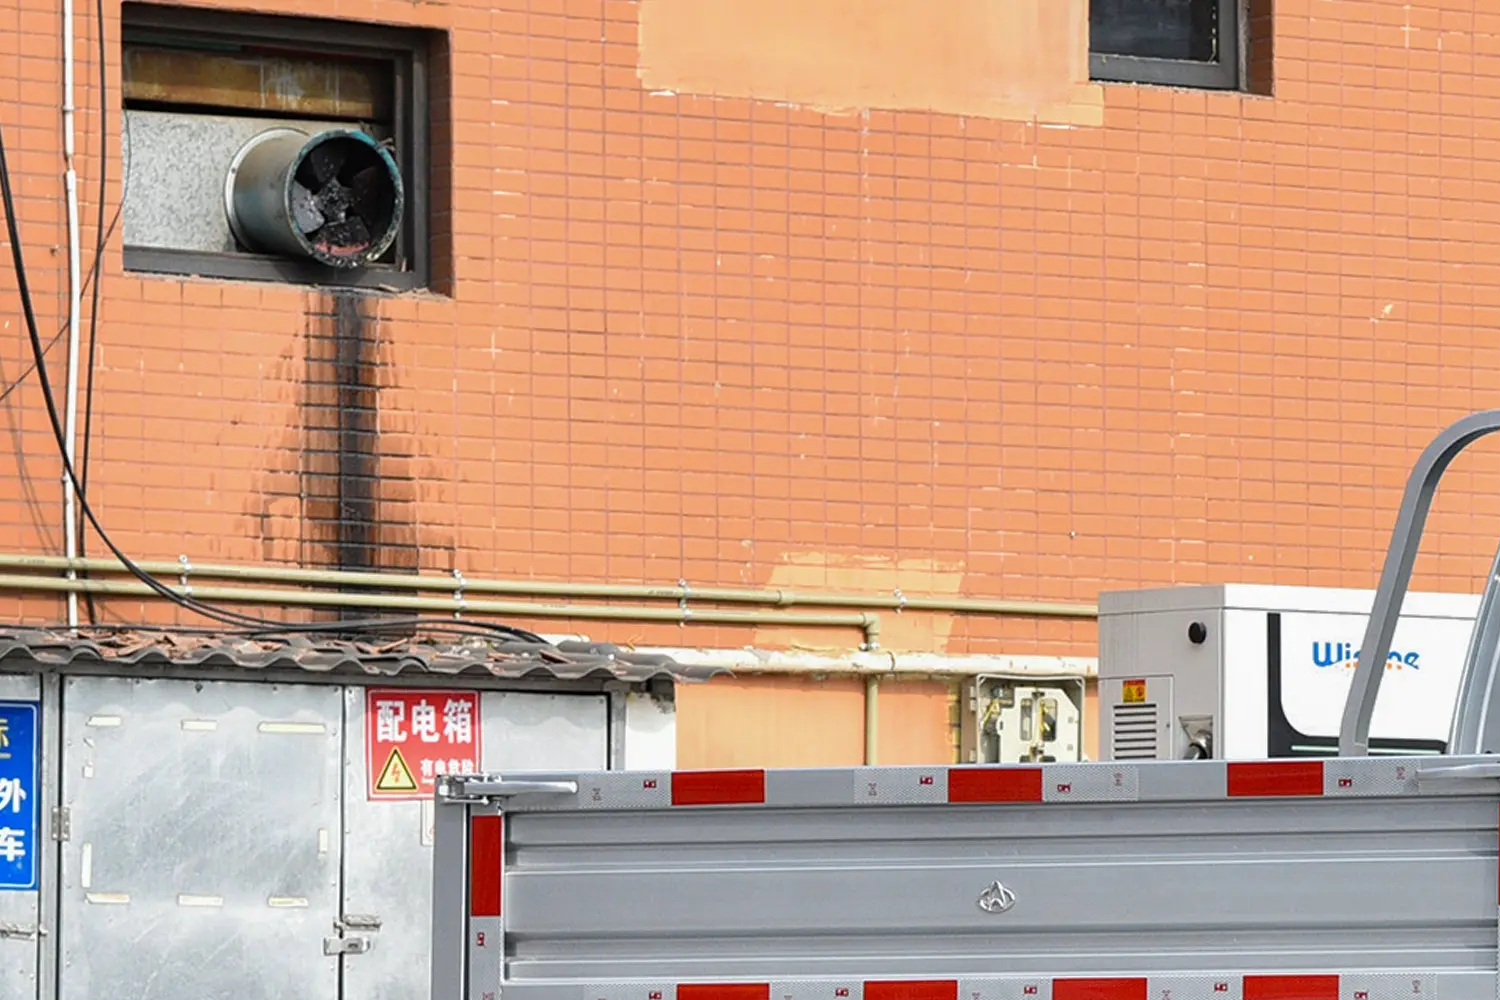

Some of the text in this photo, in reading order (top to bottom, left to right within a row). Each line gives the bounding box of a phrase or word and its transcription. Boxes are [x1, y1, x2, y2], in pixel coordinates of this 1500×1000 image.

[1312, 641, 1420, 669] Wine
[376, 699, 473, 744] 配电箱
